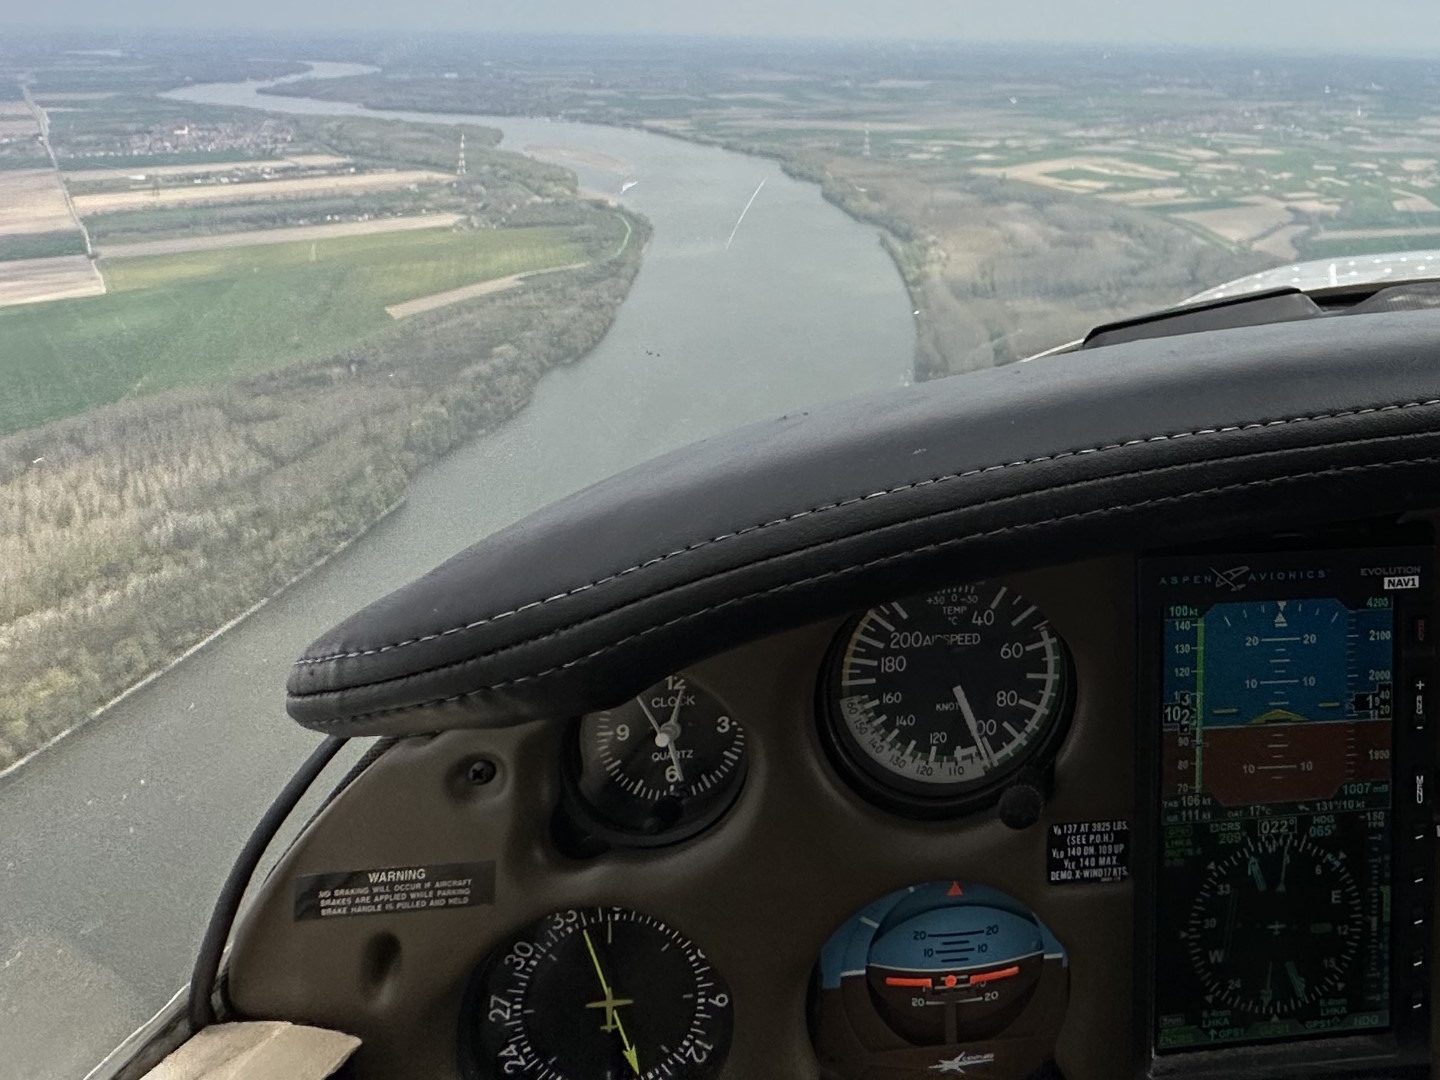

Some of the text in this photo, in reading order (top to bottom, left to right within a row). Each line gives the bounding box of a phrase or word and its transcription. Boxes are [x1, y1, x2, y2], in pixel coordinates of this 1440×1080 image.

[1158, 571, 1326, 586] ASPEN AVIONICS
[1360, 566, 1421, 576] EVOLUTION
[1388, 578, 1417, 588] NAV1
[942, 606, 967, 615] TEMP
[972, 611, 994, 626] 40
[890, 632, 923, 648] 200
[1000, 642, 1023, 658] 60
[881, 656, 906, 672] 180
[665, 675, 686, 690] 12
[652, 695, 696, 708] CLOCK
[883, 693, 902, 704] 160
[996, 690, 1018, 707] 80
[716, 716, 730, 733] 3
[895, 714, 915, 727] 140
[616, 724, 629, 741] 9
[930, 732, 947, 744] 120
[652, 749, 694, 761] QUARTZ
[665, 765, 679, 783] 6
[1064, 824, 1077, 834] 137
[1080, 823, 1090, 832] AT
[1091, 821, 1111, 832] 3925
[1112, 820, 1130, 831] LBS.
[1260, 819, 1295, 834] 022°
[1067, 834, 1087, 846] (SEE
[1067, 847, 1082, 857] 140
[1099, 844, 1113, 855] 109
[1114, 843, 1124, 854] UP
[368, 868, 426, 884] WARNING
[318, 890, 331, 898] NO
[333, 886, 369, 897] BRAKING
[372, 885, 390, 893] WILL
[394, 883, 421, 892] OCCUR
[434, 879, 472, 888] AIRCRAFT
[320, 888, 471, 907] BRAKES ARE APPLIED WHILE PARKING
[1331, 891, 1342, 904] E
[321, 908, 348, 916] BRAKE
[351, 904, 382, 913] HANDLE
[396, 900, 426, 910] PULLED
[429, 898, 446, 907] AND
[448, 896, 468, 905] HELD
[913, 931, 926, 940] 20
[986, 925, 999, 935] 20
[504, 941, 534, 970] 30
[923, 948, 933, 957] 10
[977, 943, 988, 953] 10
[1208, 950, 1224, 963] W
[488, 994, 511, 1022] 27
[688, 1039, 713, 1063] 12
[497, 1044, 527, 1074] 24
